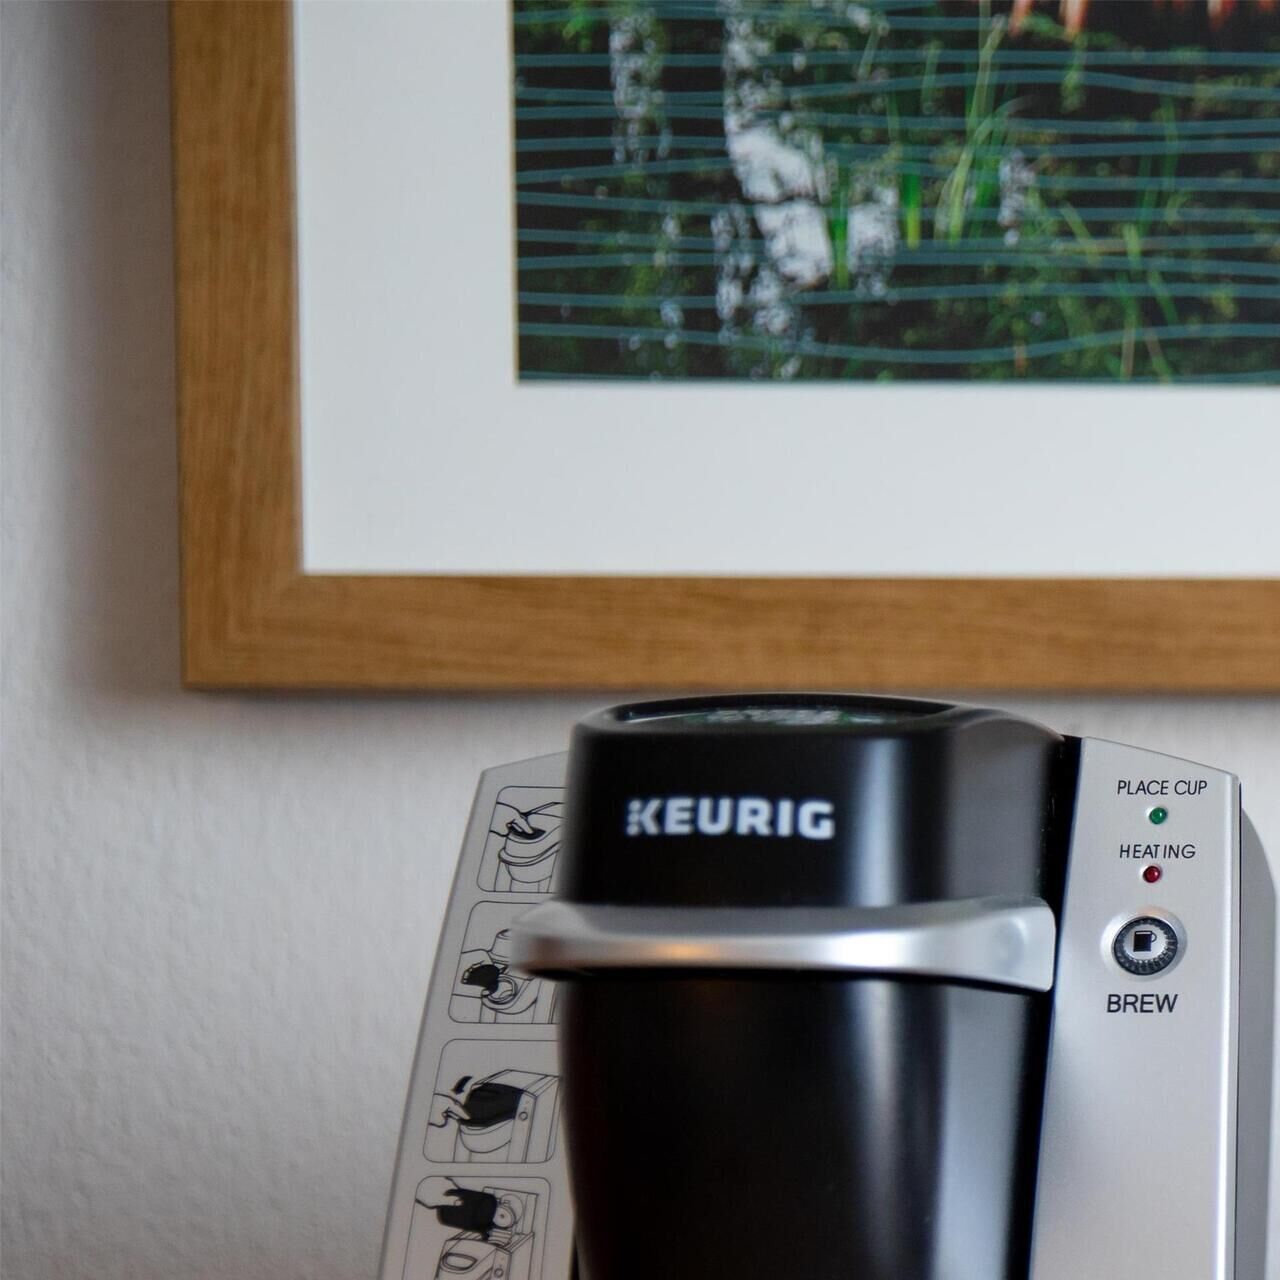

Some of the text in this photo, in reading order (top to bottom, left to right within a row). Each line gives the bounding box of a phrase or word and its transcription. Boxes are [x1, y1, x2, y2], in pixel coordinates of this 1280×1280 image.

[1117, 779, 1208, 795] PLACE CUP
[627, 798, 835, 841] KEURIG
[1119, 844, 1196, 859] HEATING
[1106, 993, 1179, 1014] BREW
